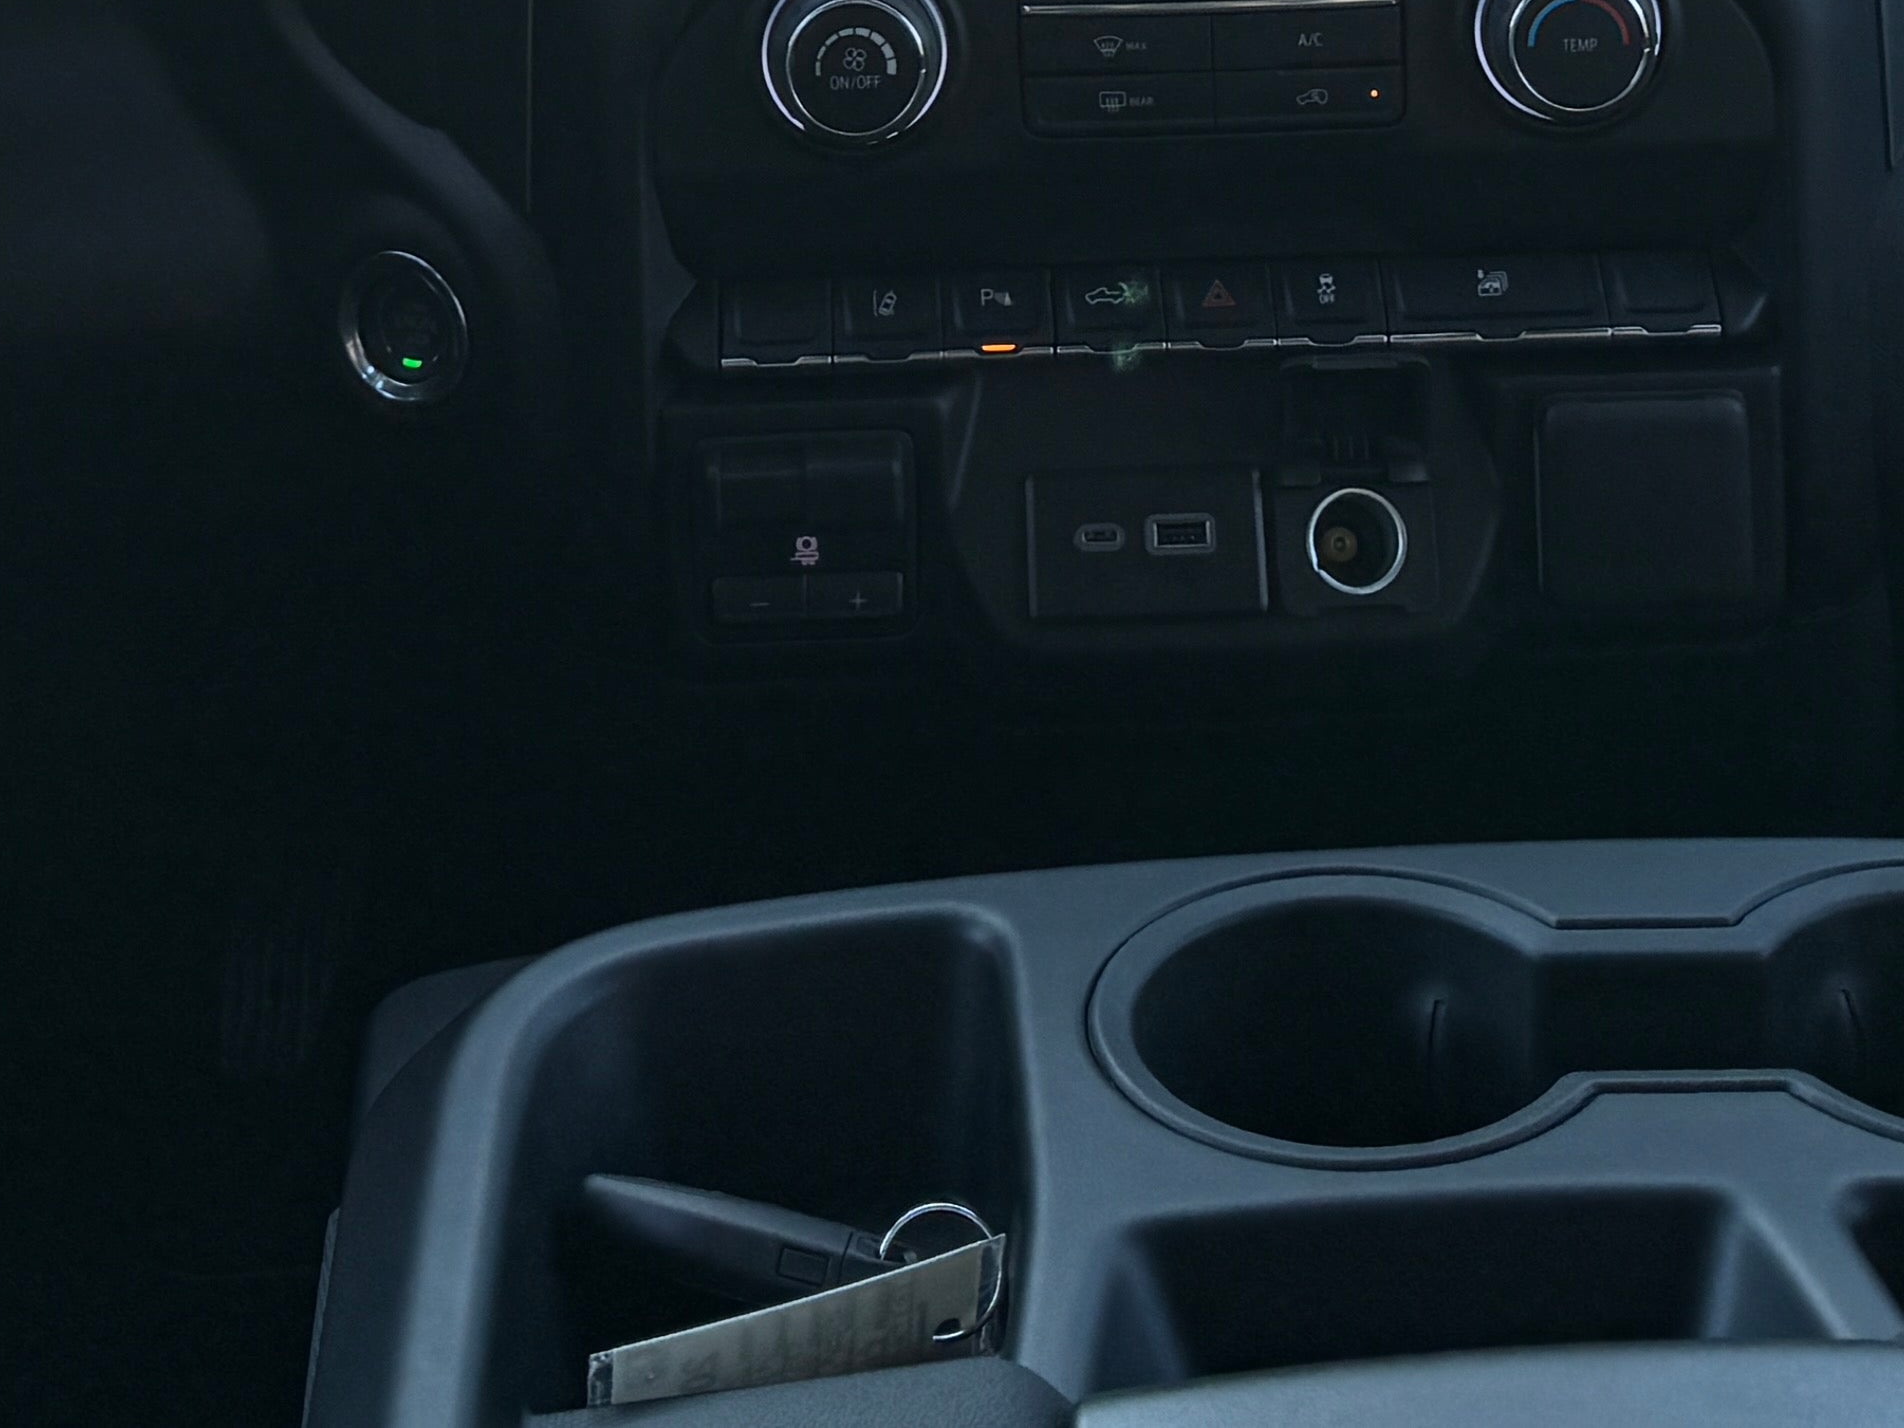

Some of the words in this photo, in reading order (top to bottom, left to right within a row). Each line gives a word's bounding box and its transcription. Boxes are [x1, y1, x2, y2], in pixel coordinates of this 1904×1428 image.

[1297, 32, 1324, 47] A/C
[1563, 38, 1598, 52] TEMP
[830, 75, 881, 90] ON/OFF
